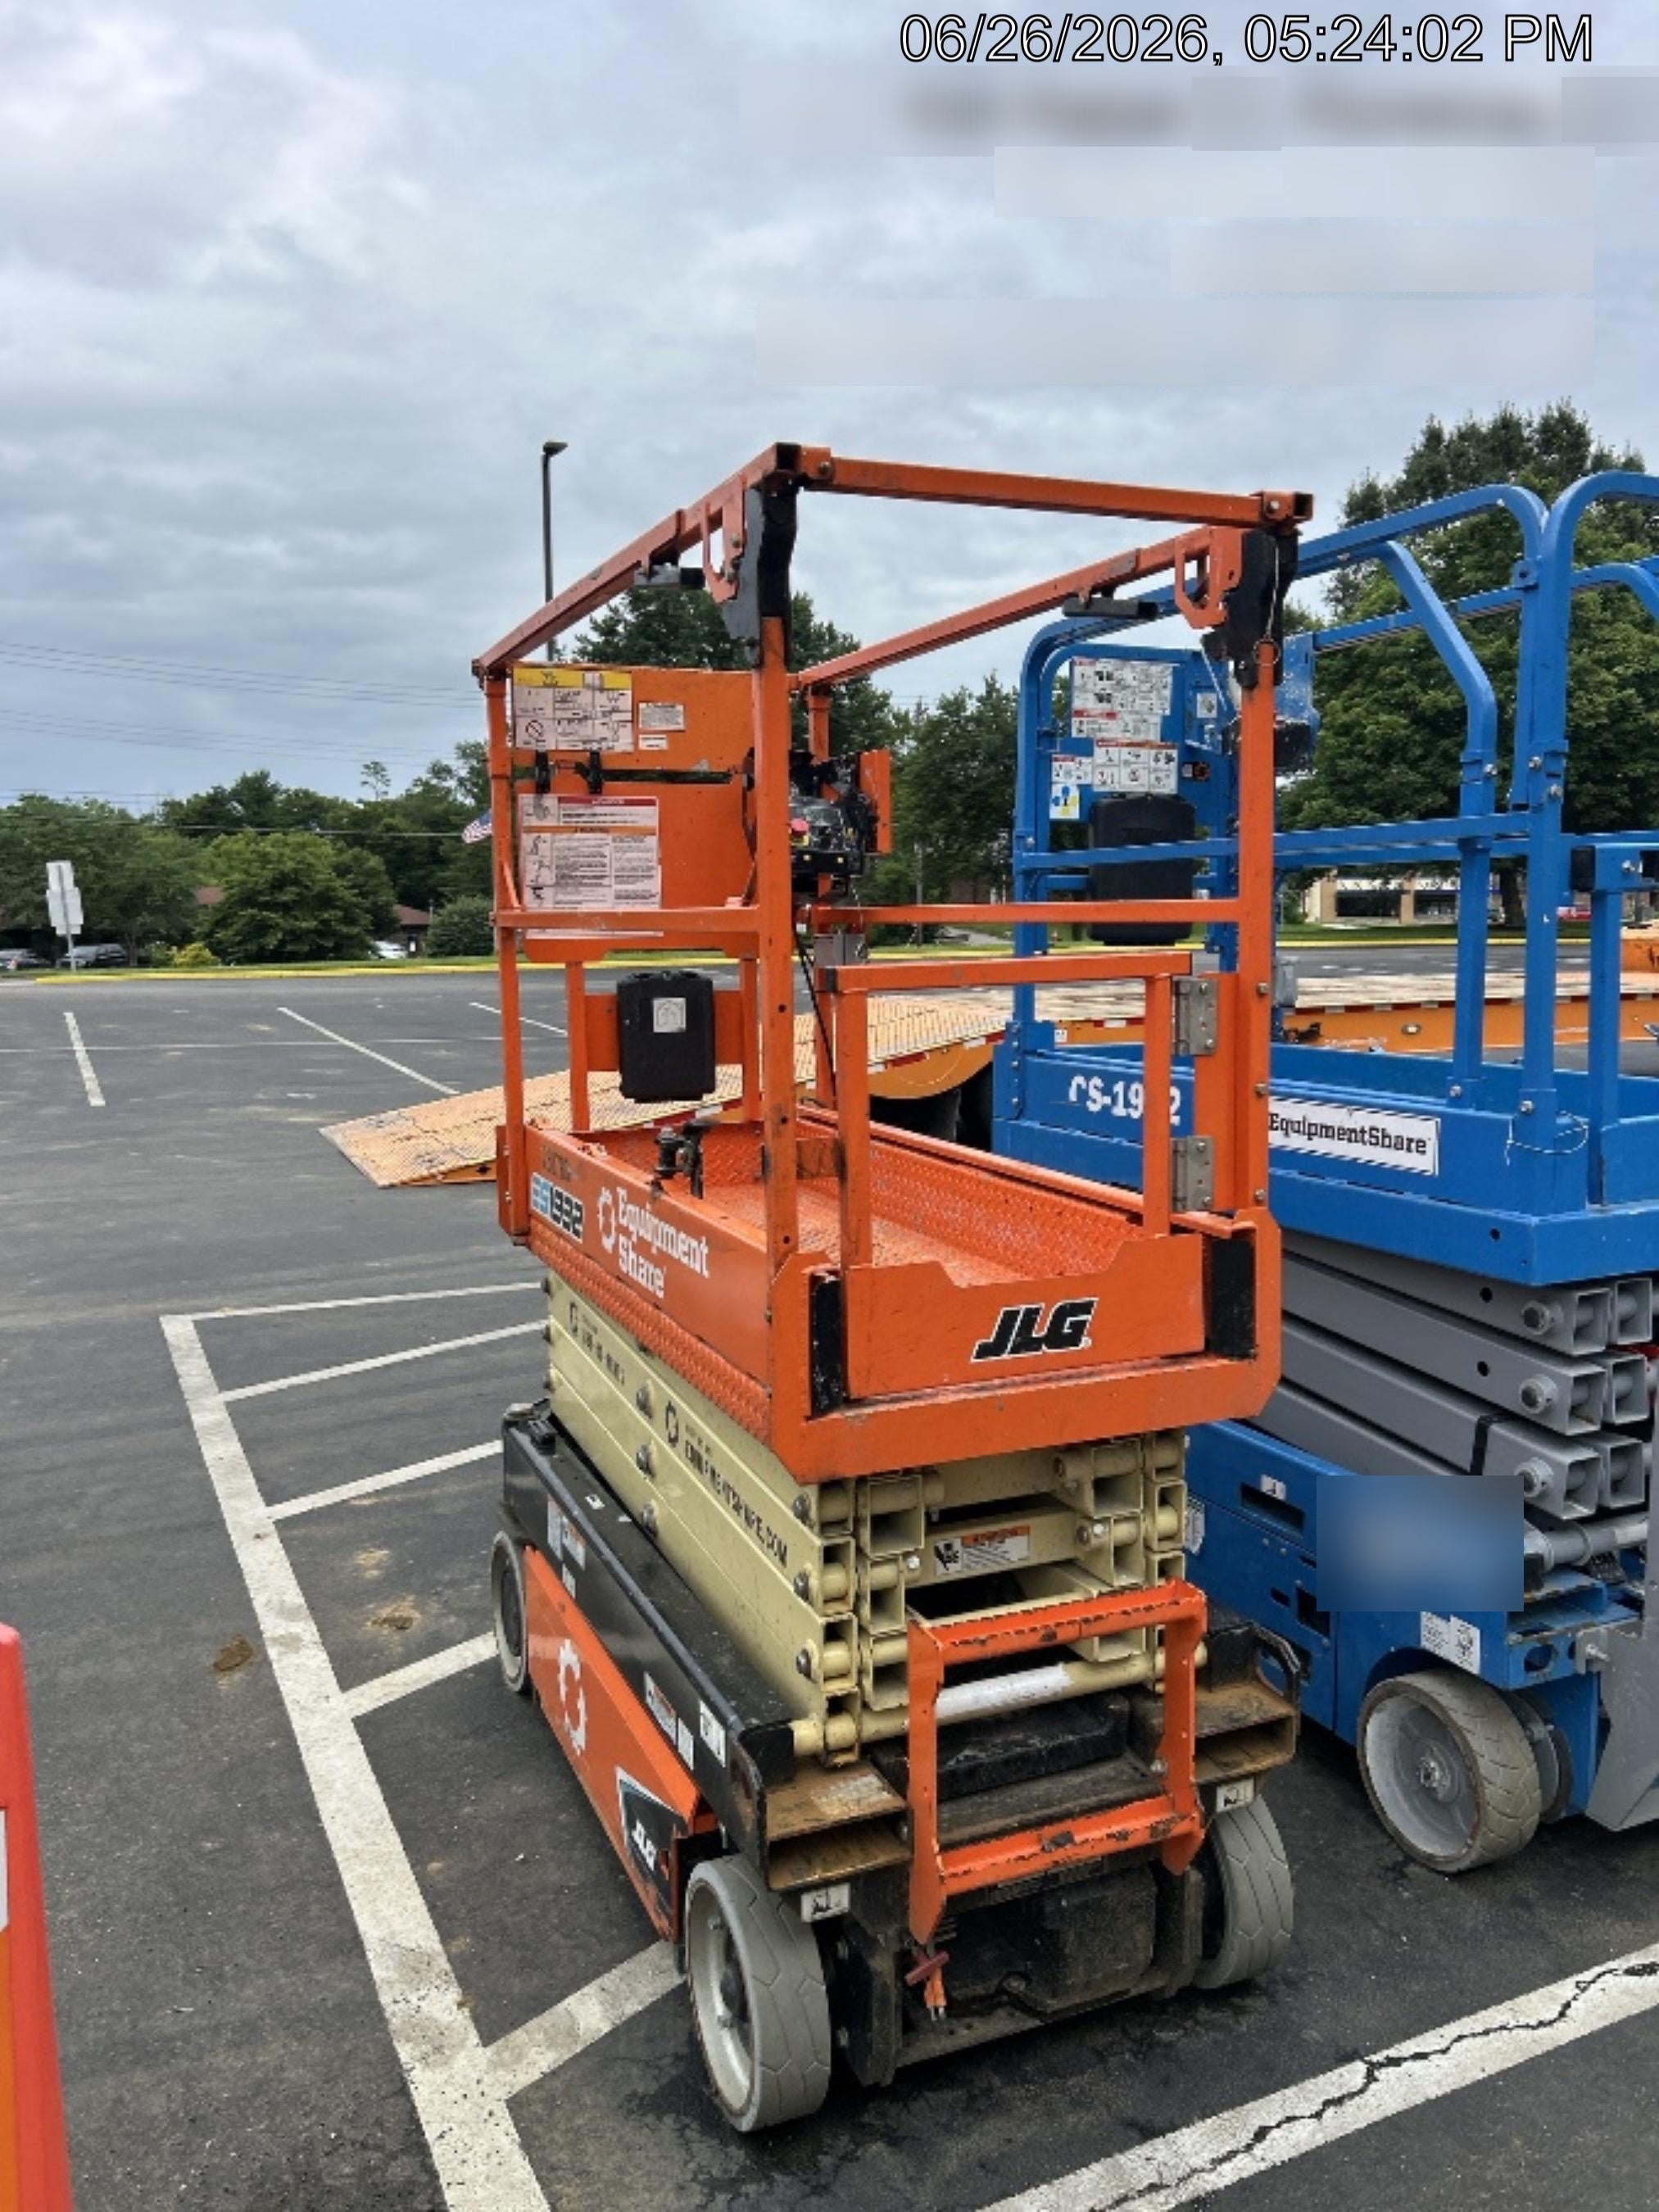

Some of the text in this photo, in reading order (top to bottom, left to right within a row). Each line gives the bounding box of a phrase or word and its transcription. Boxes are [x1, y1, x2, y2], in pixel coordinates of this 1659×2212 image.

[1068, 1073, 1181, 1127] S-192
[616, 1187, 709, 1279] Equipment
[619, 1235, 665, 1299] Share
[971, 1298, 1099, 1362] JLG
